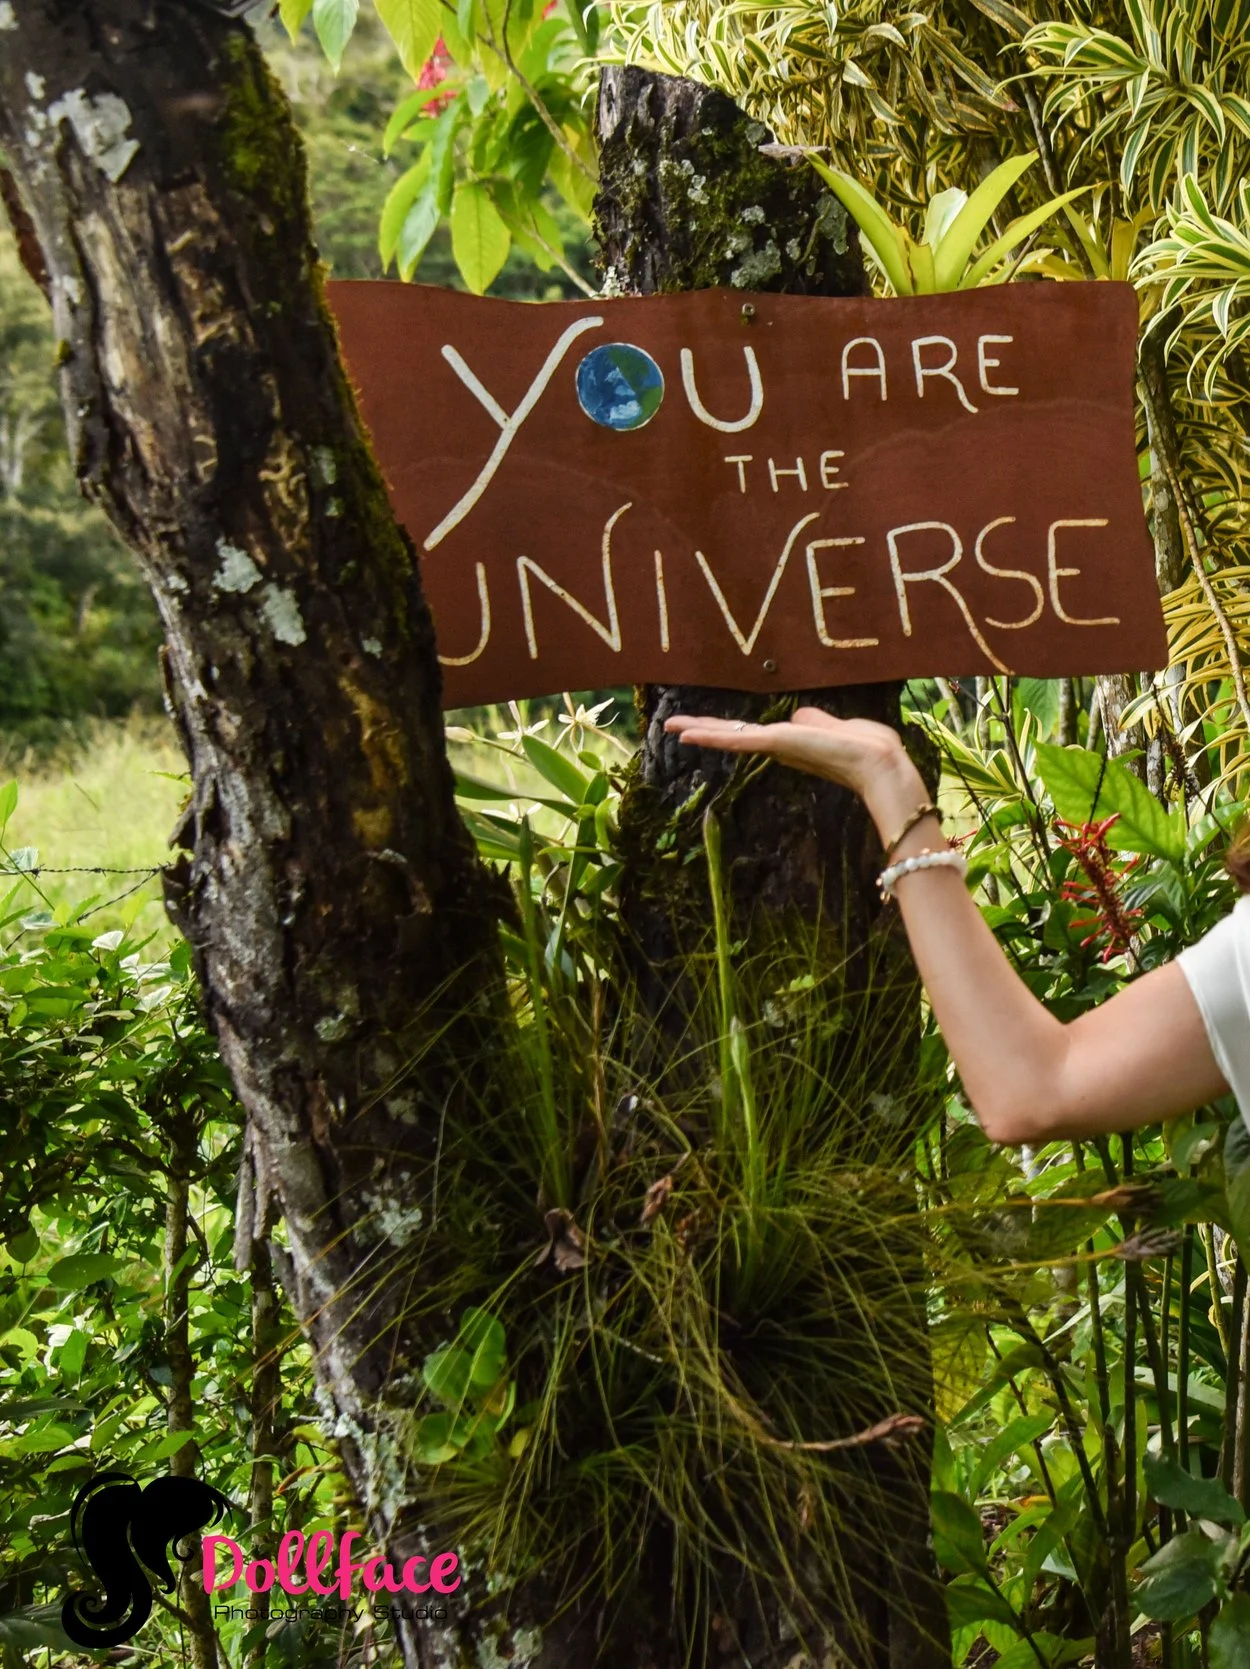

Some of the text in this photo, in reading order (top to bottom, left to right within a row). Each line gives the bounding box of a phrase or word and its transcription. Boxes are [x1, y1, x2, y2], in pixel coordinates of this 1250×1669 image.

[423, 316, 1020, 552] YOU ARE
[725, 450, 848, 493] THE
